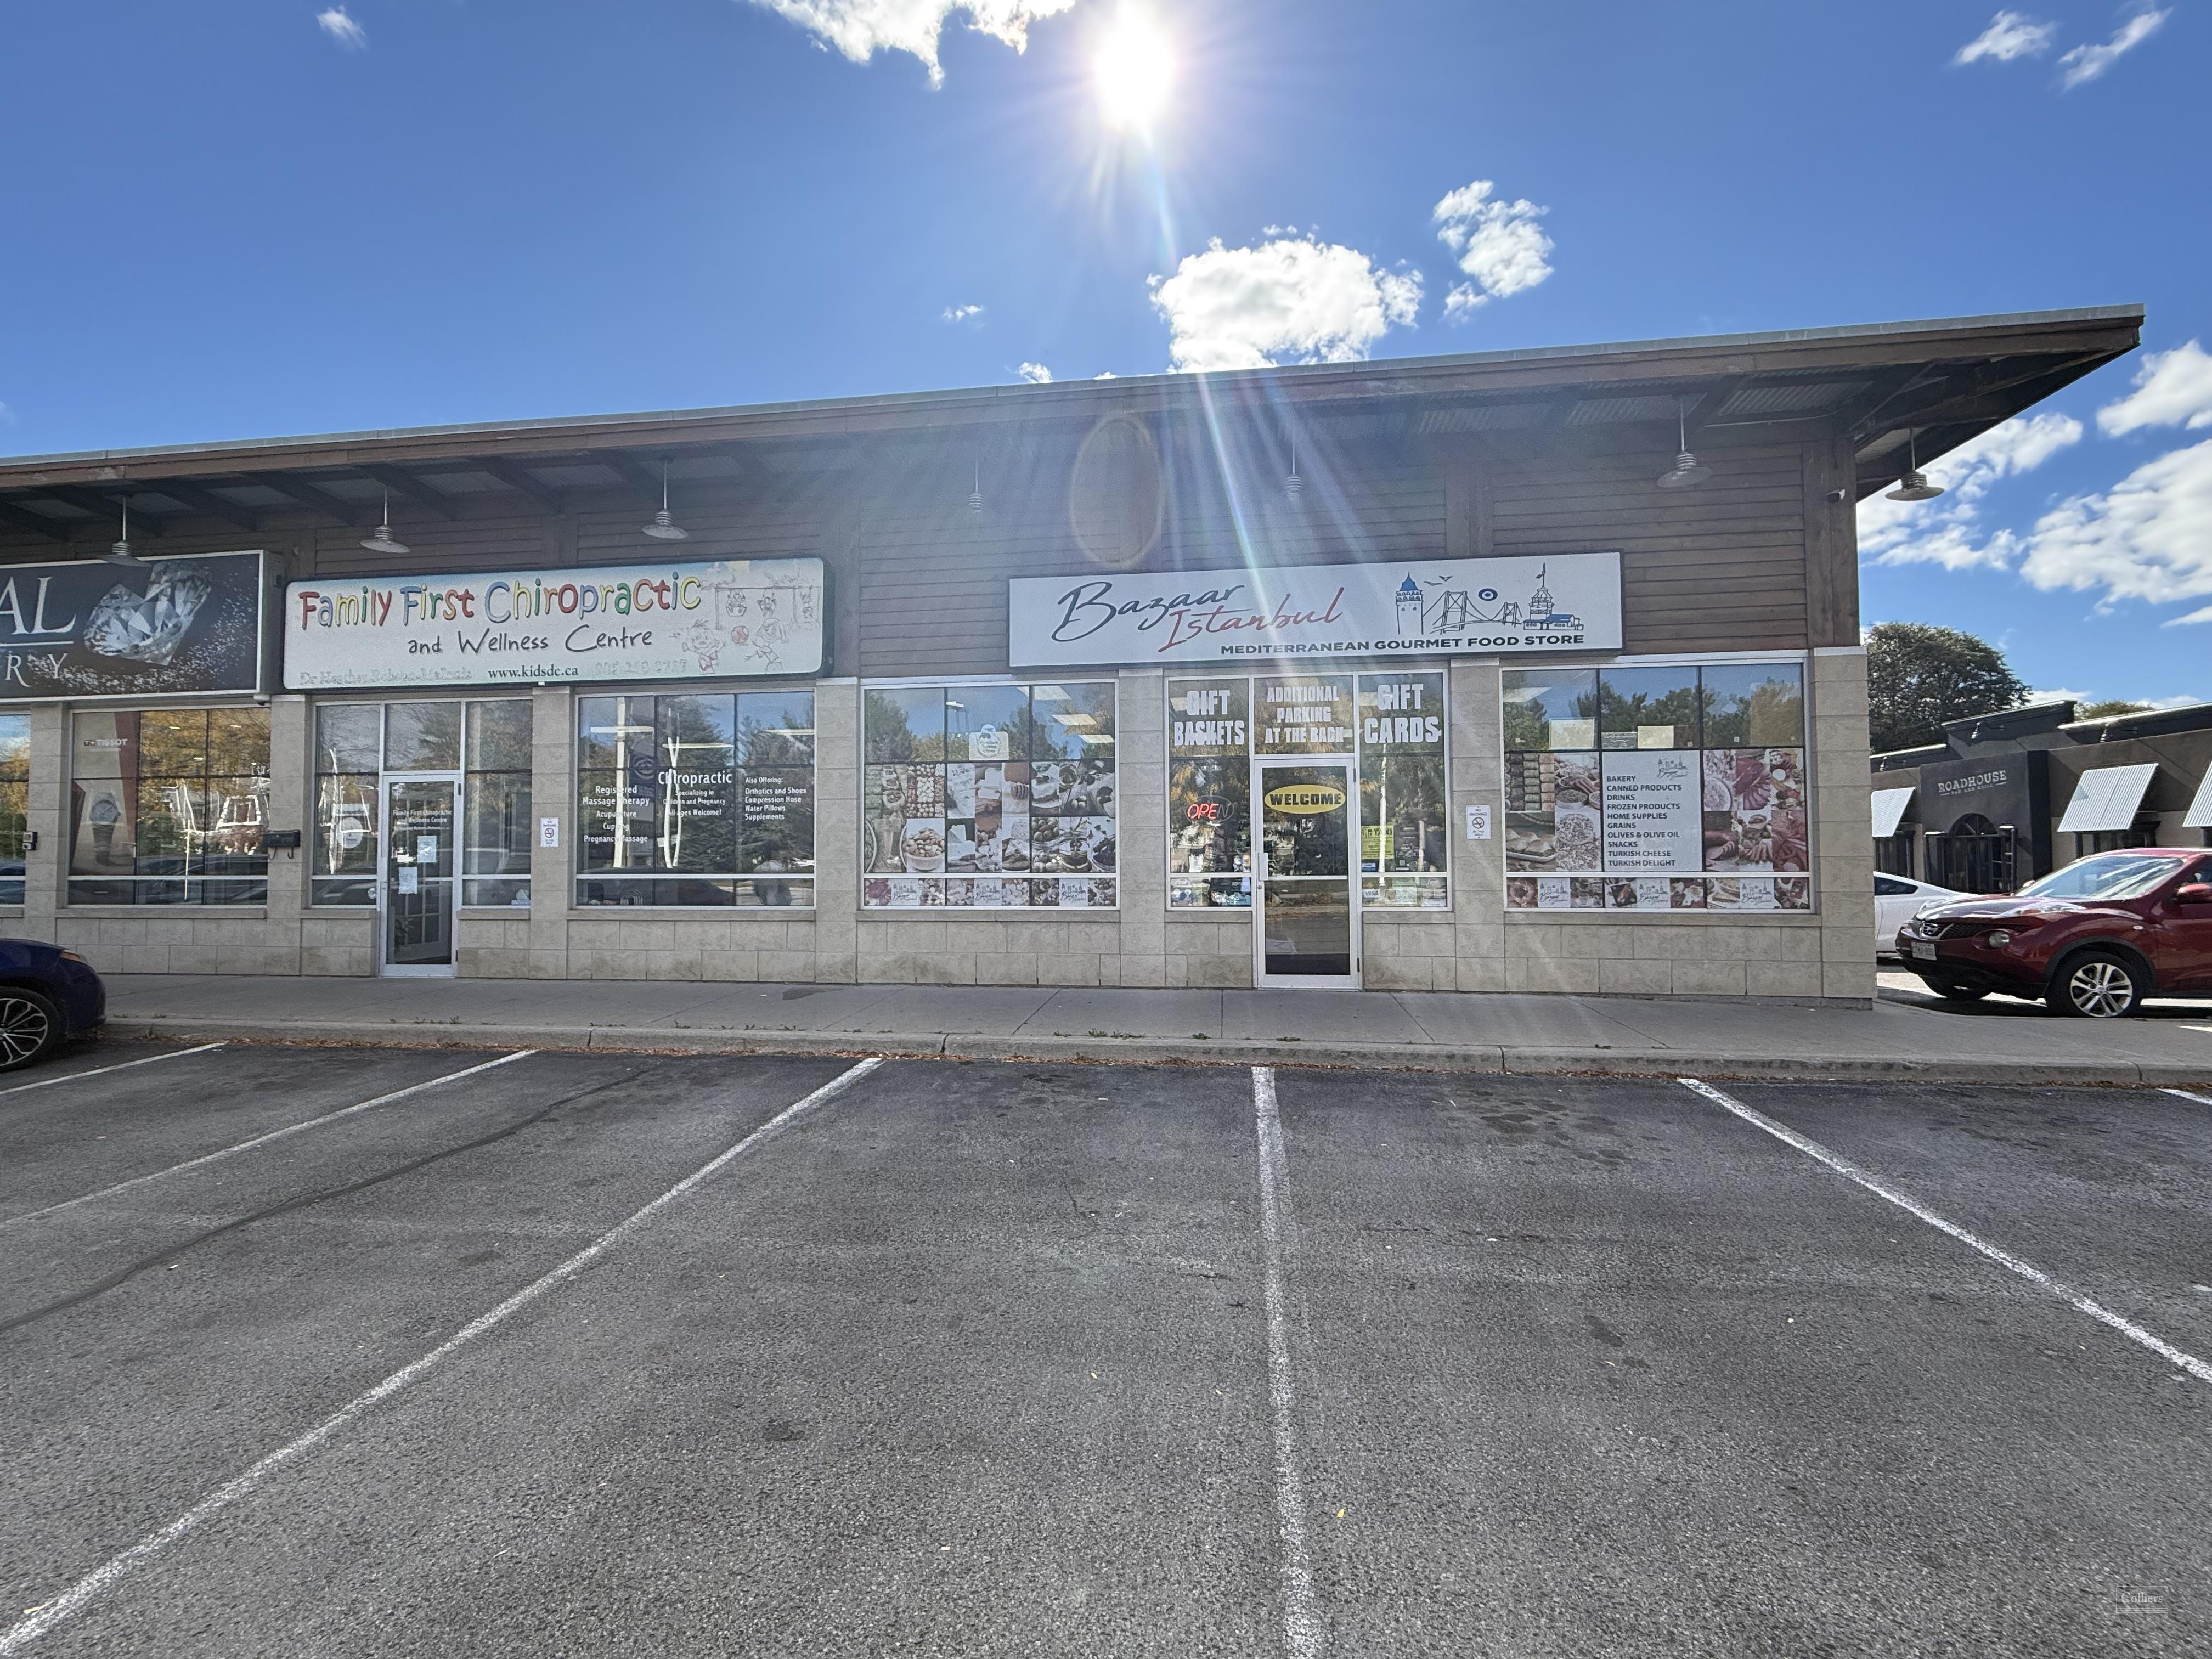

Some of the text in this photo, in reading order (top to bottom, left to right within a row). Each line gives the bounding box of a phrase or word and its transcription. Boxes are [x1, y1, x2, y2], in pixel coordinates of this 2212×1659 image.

[298, 571, 701, 630] Family First Chiropractic
[1051, 582, 1245, 642] Bazaar
[1158, 587, 1344, 653] Istanbul
[408, 624, 652, 654] and Wellness Centre
[1221, 634, 1584, 654] MEDITERRANEAN GOURMET FOOD STORE
[488, 664, 579, 679] www.kidsdc.ca
[1187, 690, 1231, 715] GIFT
[1267, 686, 1339, 702] ADDITIONAL
[1377, 684, 1424, 710] GIFT
[1277, 707, 1331, 723] PARKING
[1174, 720, 1244, 746] BASKETS
[1265, 727, 1344, 743] AT THE BACK
[1364, 716, 1440, 744] CARDS
[1938, 770, 2006, 792] ROADHOUSE
[583, 796, 650, 807] Massage herapy
[698, 797, 726, 805] Pregnancy
[745, 796, 784, 804] Compression
[1269, 793, 1342, 806] WELCOME
[745, 813, 785, 822] Supplements
[620, 835, 648, 844] assage
